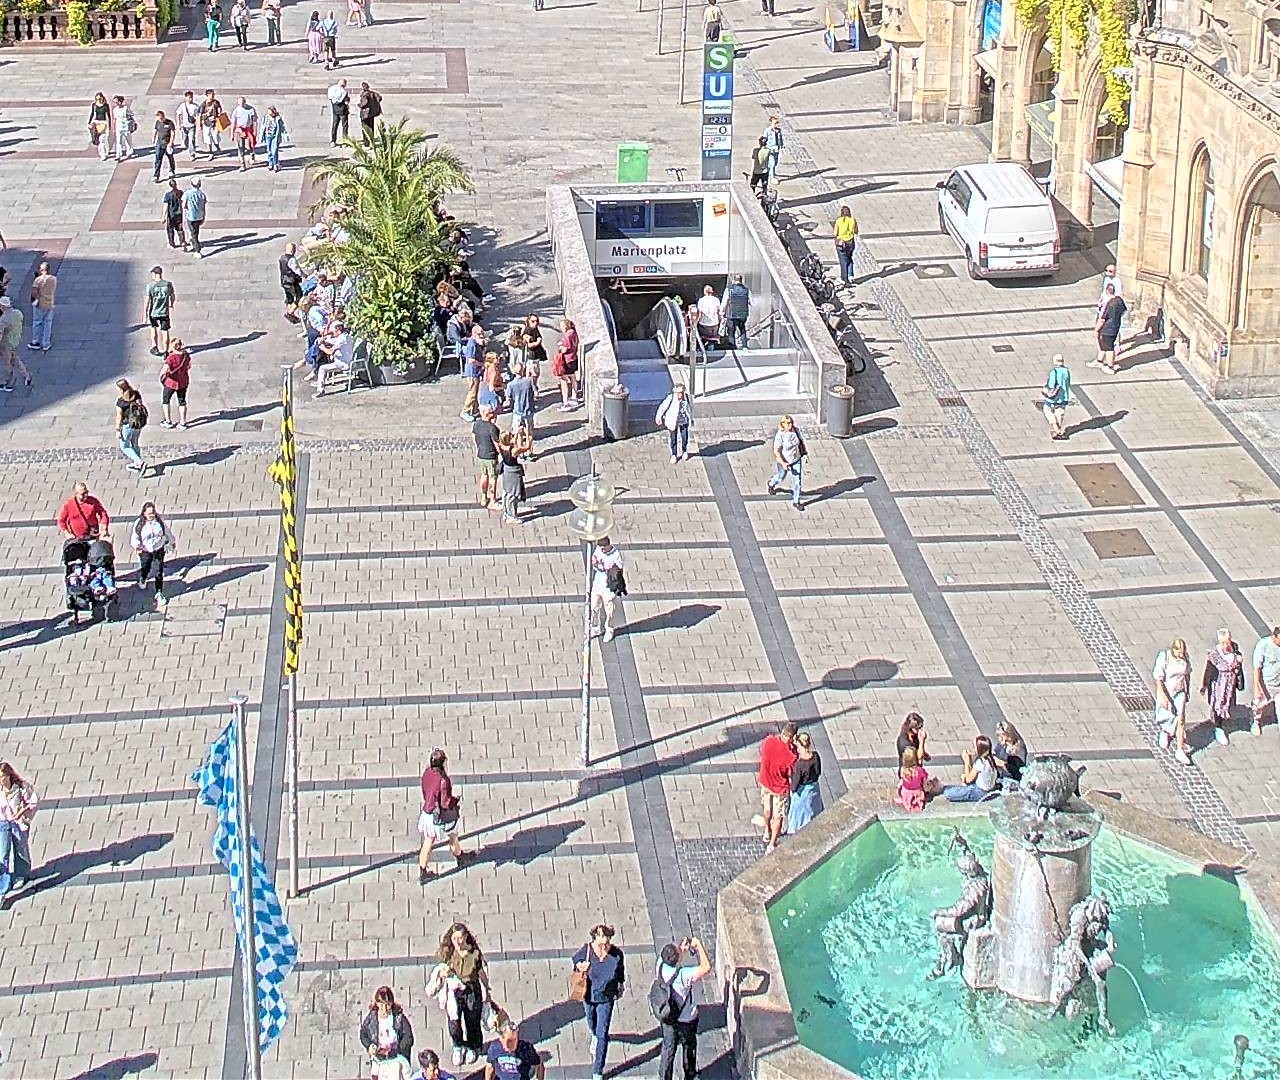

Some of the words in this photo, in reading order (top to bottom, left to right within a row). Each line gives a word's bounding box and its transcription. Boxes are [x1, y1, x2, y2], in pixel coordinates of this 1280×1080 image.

[708, 47, 729, 70] S
[709, 75, 727, 97] U
[611, 245, 687, 257] Marienplatz
